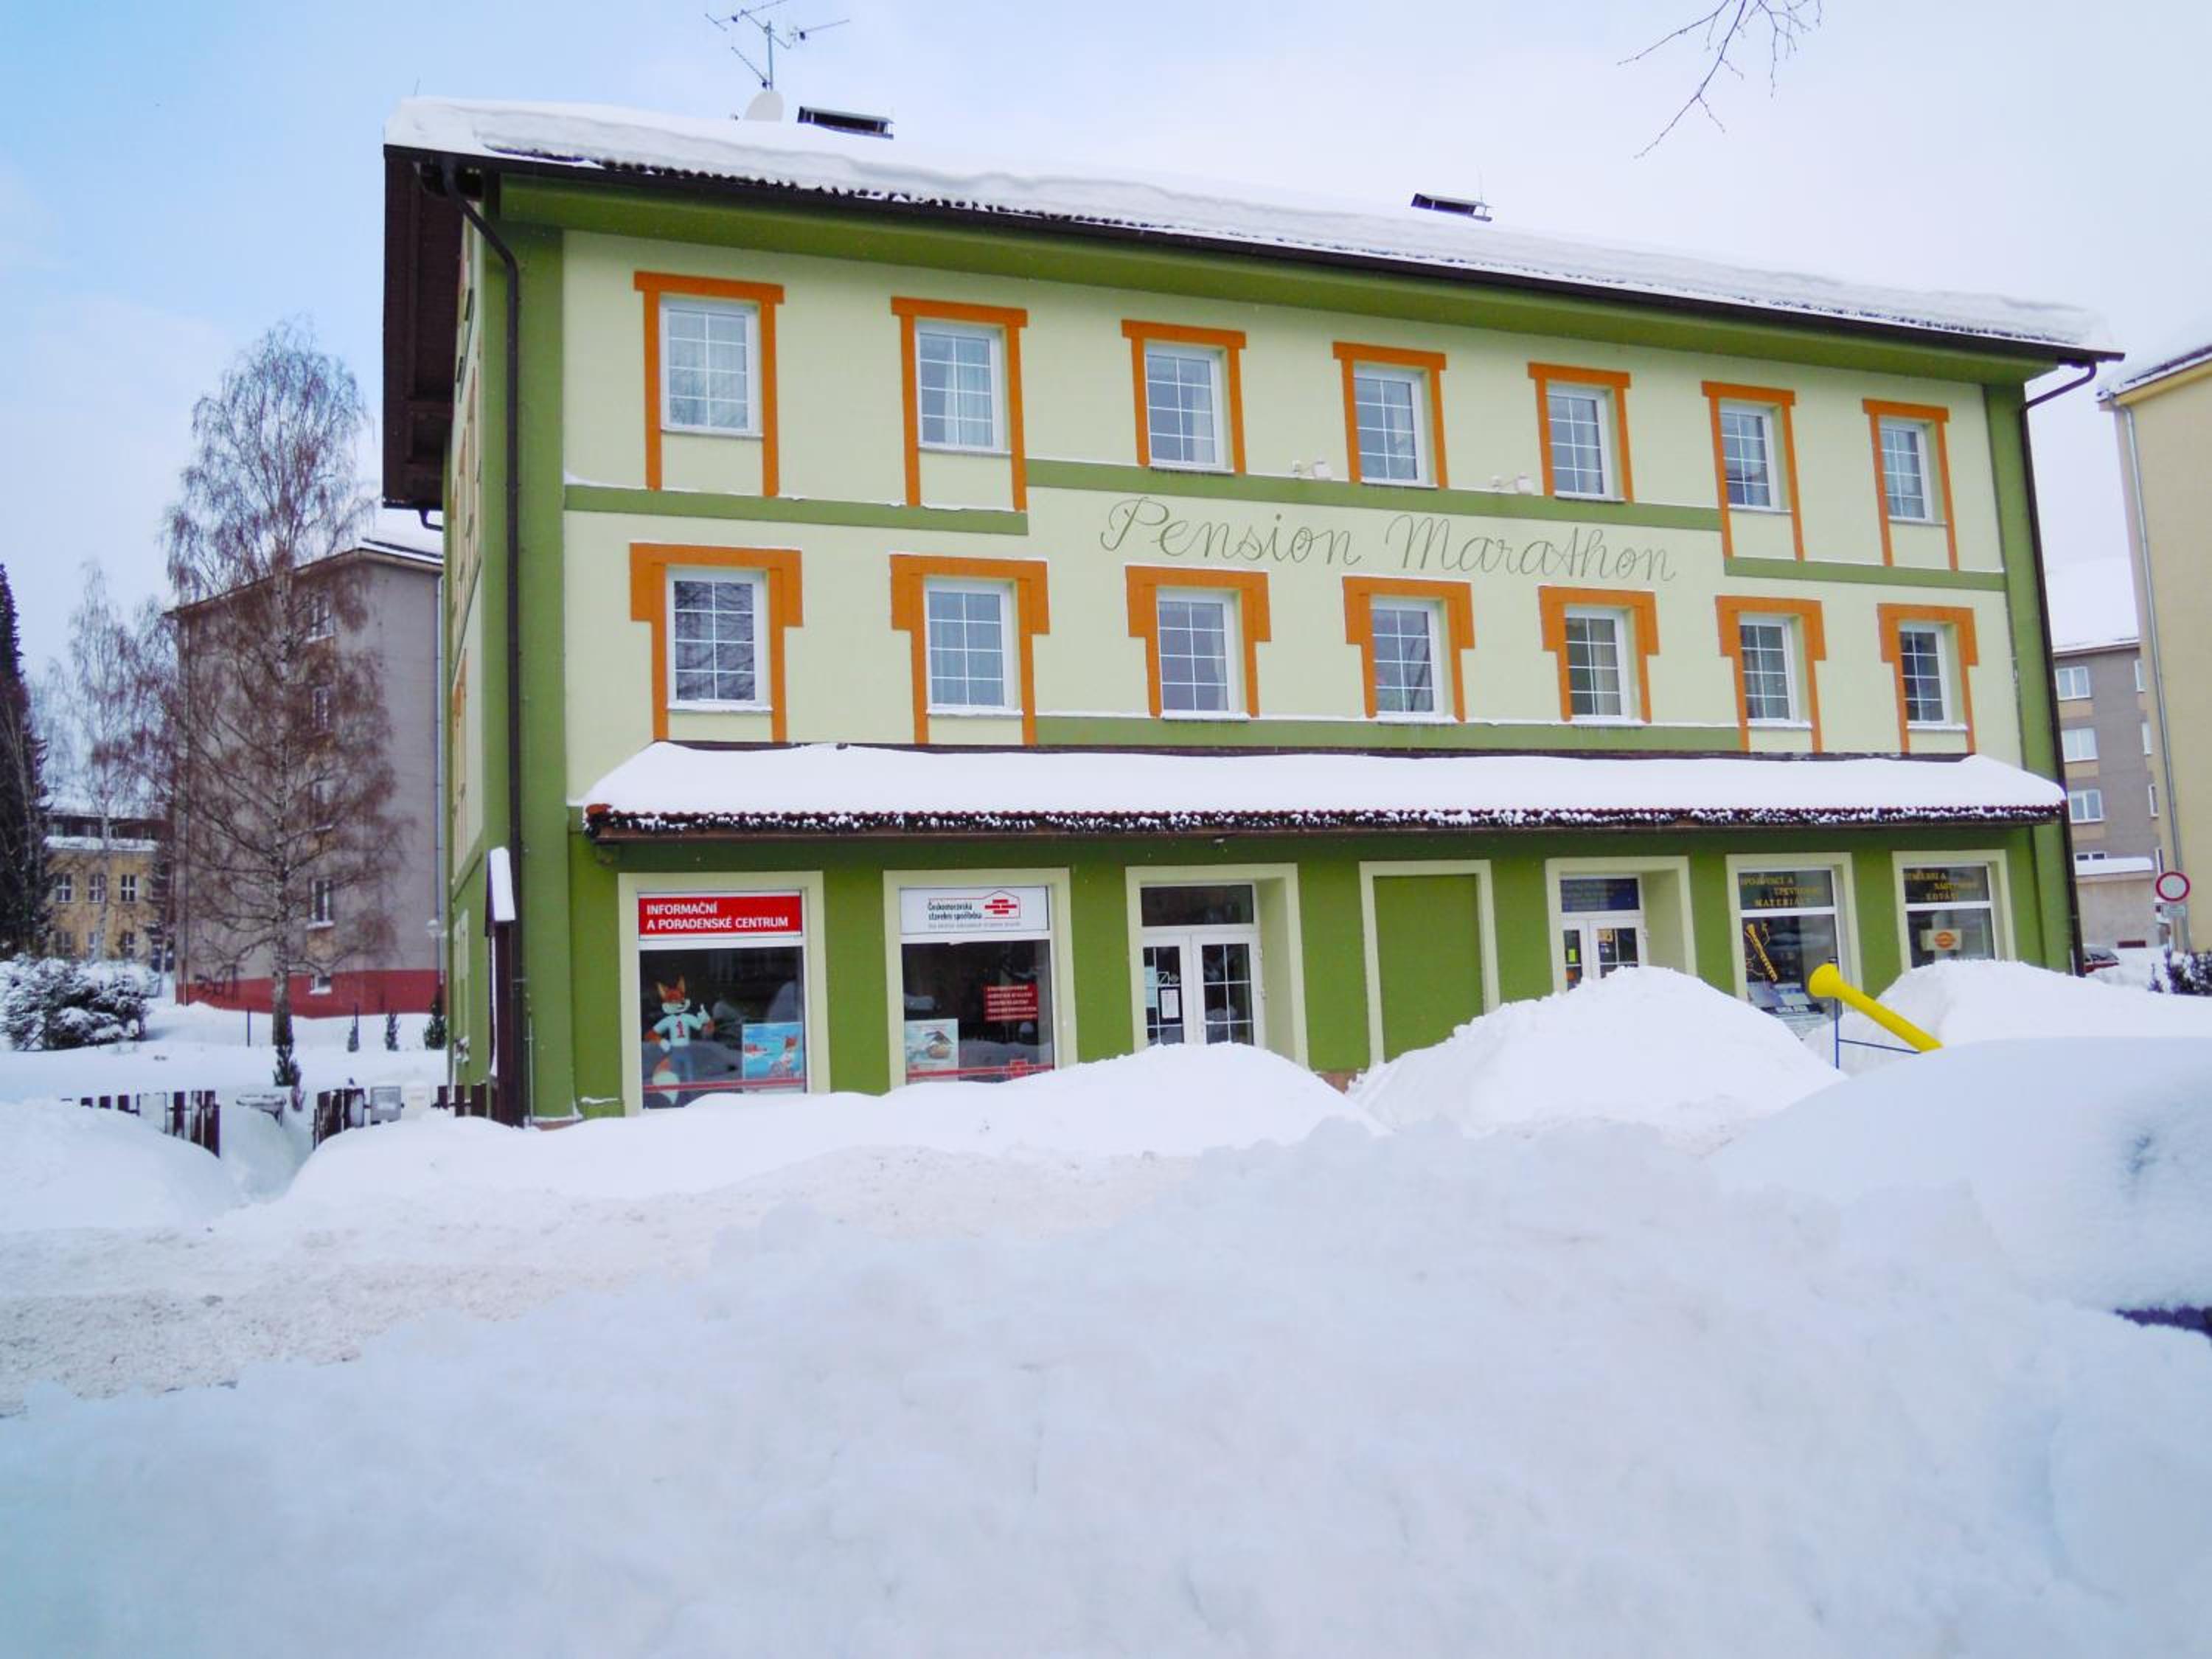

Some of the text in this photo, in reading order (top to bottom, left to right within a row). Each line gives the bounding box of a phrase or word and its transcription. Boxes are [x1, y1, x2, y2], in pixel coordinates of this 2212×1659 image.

[1100, 496, 1676, 582] Pension Marathon
[646, 901, 717, 915] INFORMAČNÍ
[647, 916, 788, 930] A PORADENSKÉ CENTRUM
